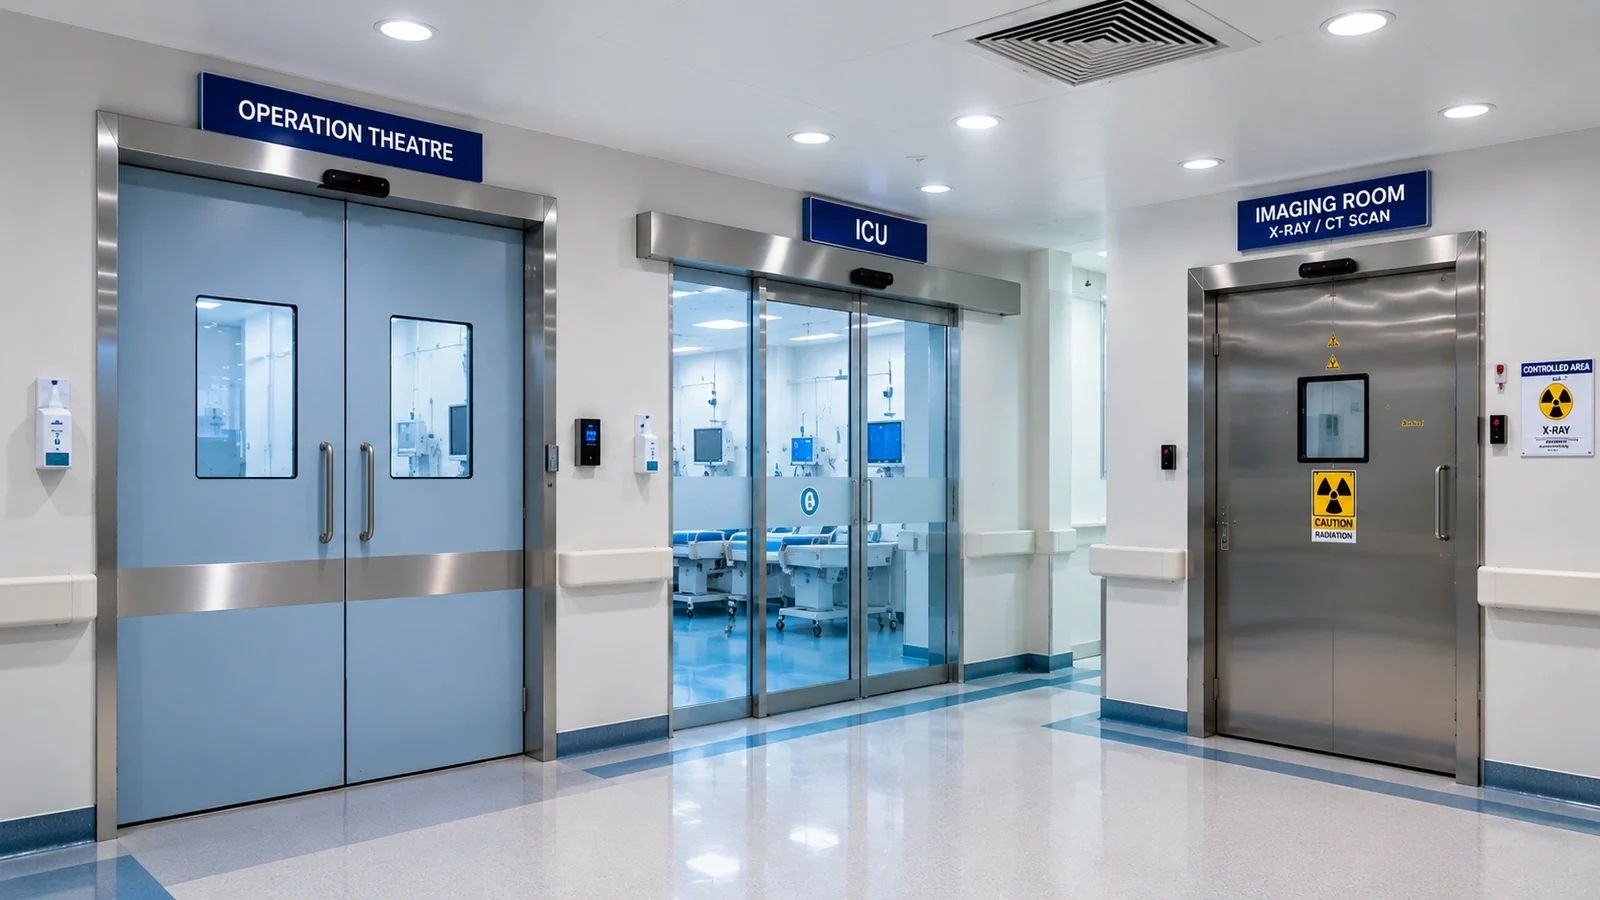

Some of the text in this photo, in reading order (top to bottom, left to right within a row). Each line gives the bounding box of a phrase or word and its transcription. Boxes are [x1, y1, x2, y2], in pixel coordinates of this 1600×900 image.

[238, 99, 453, 162] OPERATION THEATRE
[1256, 184, 1405, 223] IMAGING ROOM
[856, 219, 888, 245] ICU
[1269, 209, 1390, 239] X-RAY / CT SCAN
[1523, 362, 1591, 374] CONTROLLED AREA
[1542, 425, 1570, 435] X-RAY
[1315, 518, 1353, 528] CAUTION
[1315, 531, 1353, 539] RADIATION
